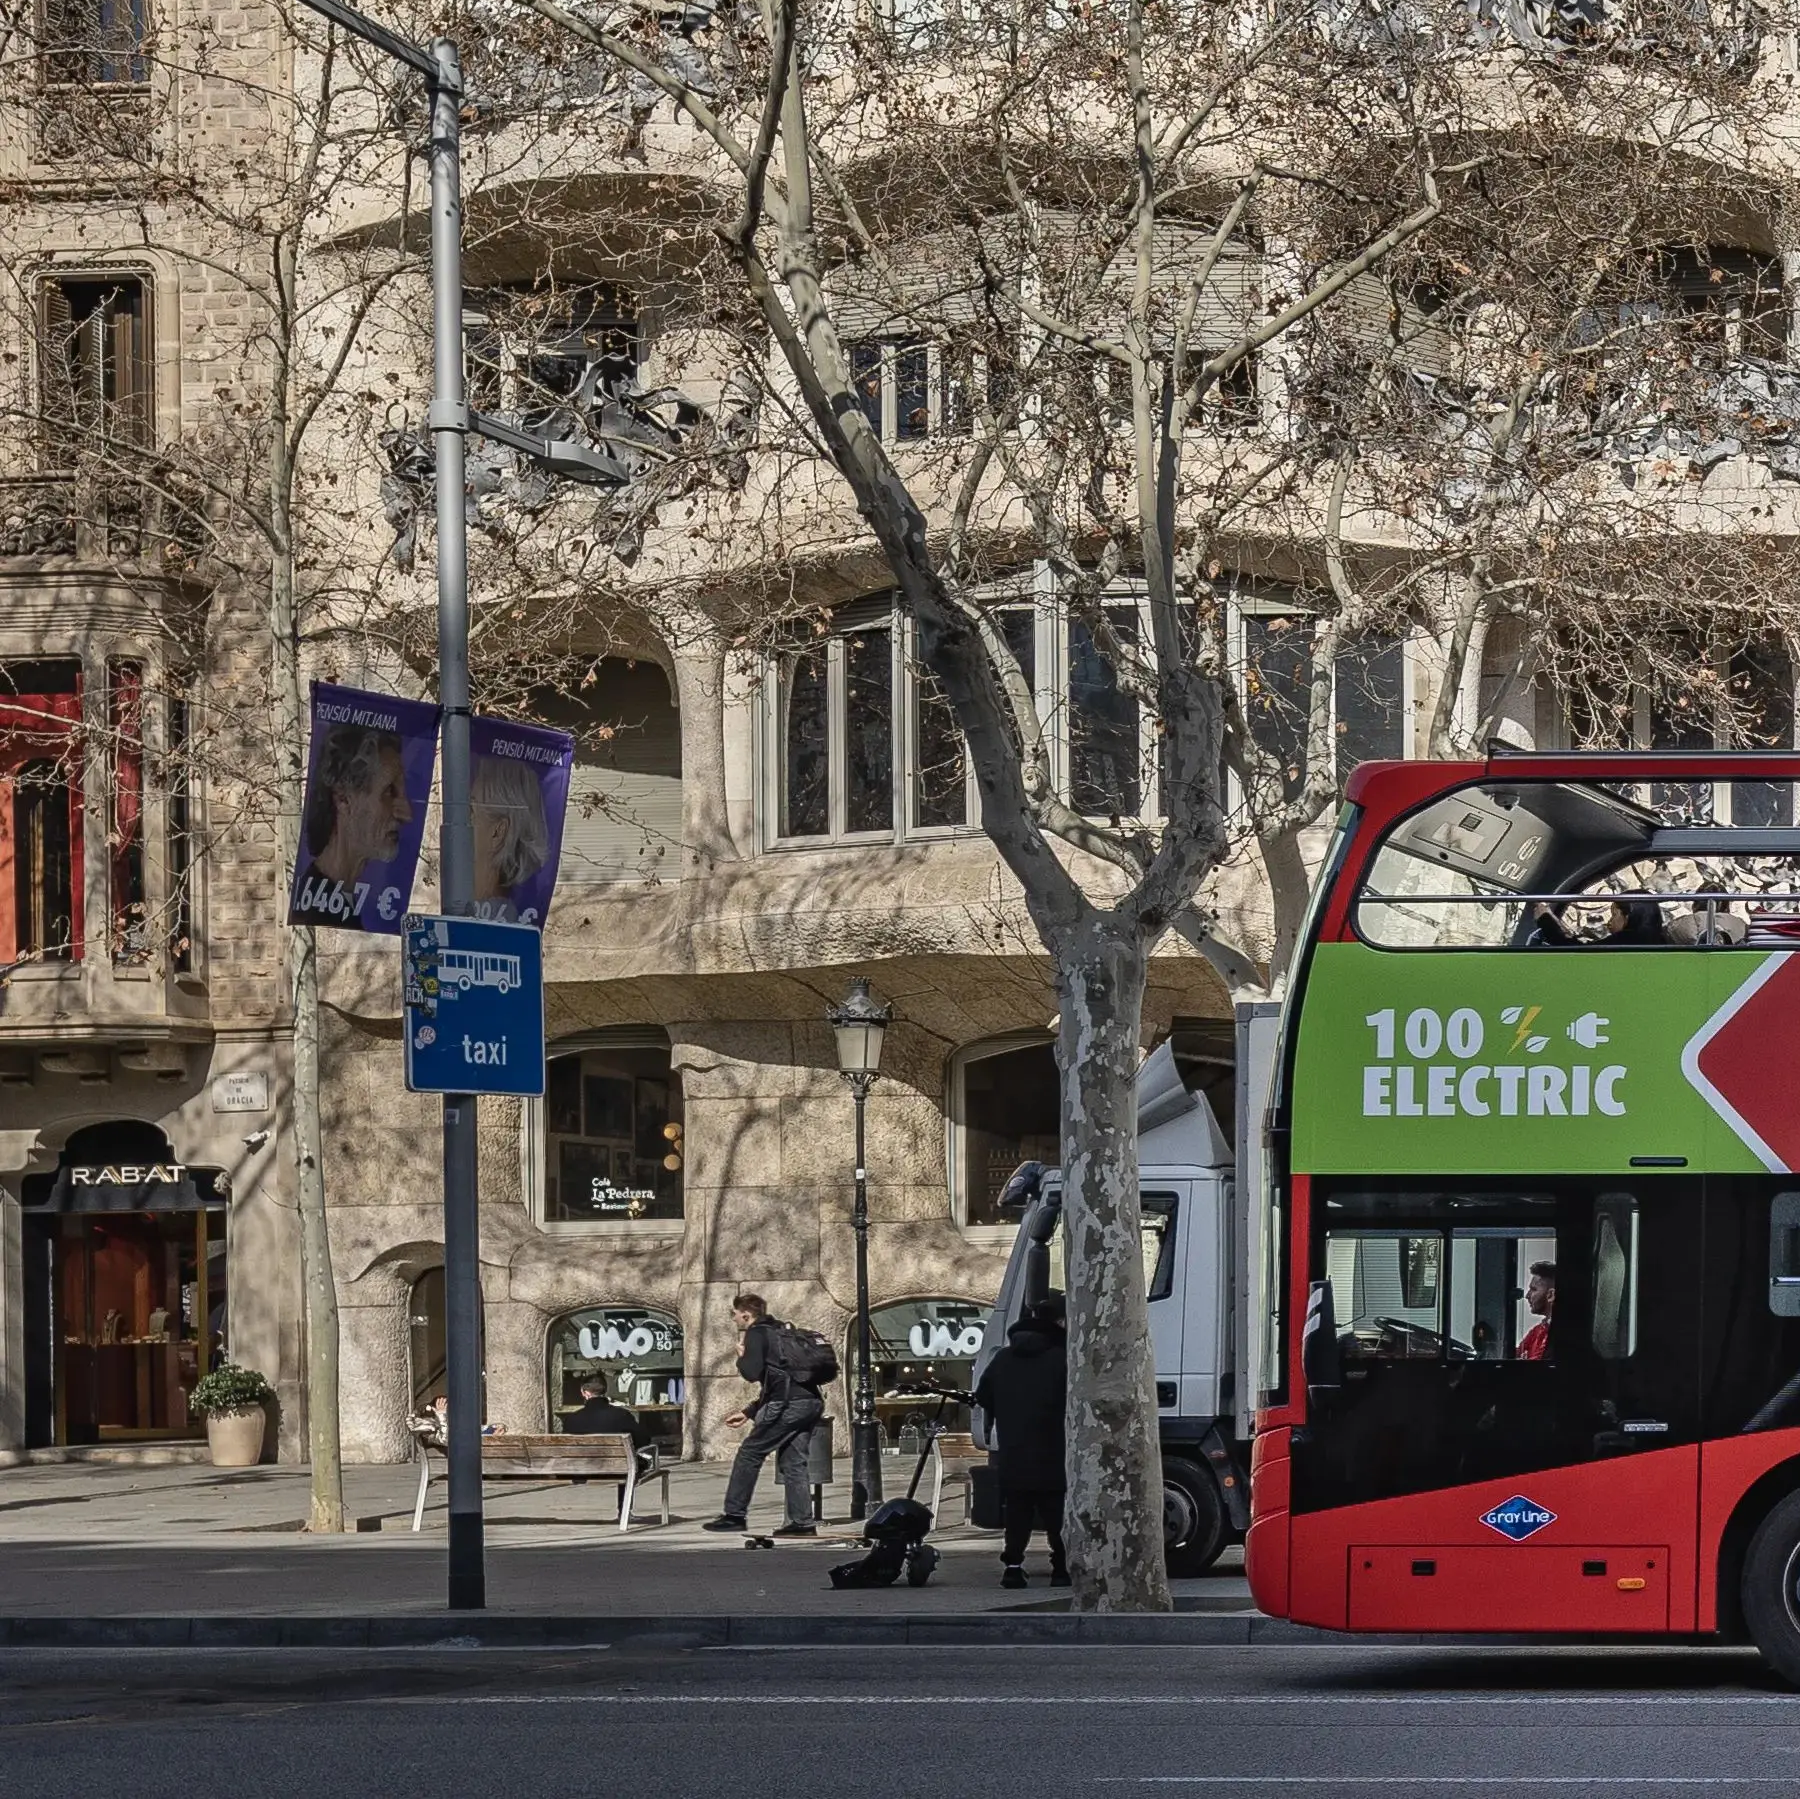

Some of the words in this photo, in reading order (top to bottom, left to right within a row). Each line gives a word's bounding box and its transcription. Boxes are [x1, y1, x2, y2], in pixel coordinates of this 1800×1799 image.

[352, 709, 398, 732] MITJANA
[491, 739, 525, 759] PENSIÓ
[525, 745, 563, 767] MITJANA
[462, 1034, 507, 1066] taxi
[1362, 1065, 1627, 1117] ELECTRIC
[72, 1165, 186, 1185] RABAT
[606, 1187, 656, 1199] Pedrera
[579, 1327, 654, 1358] UNO
